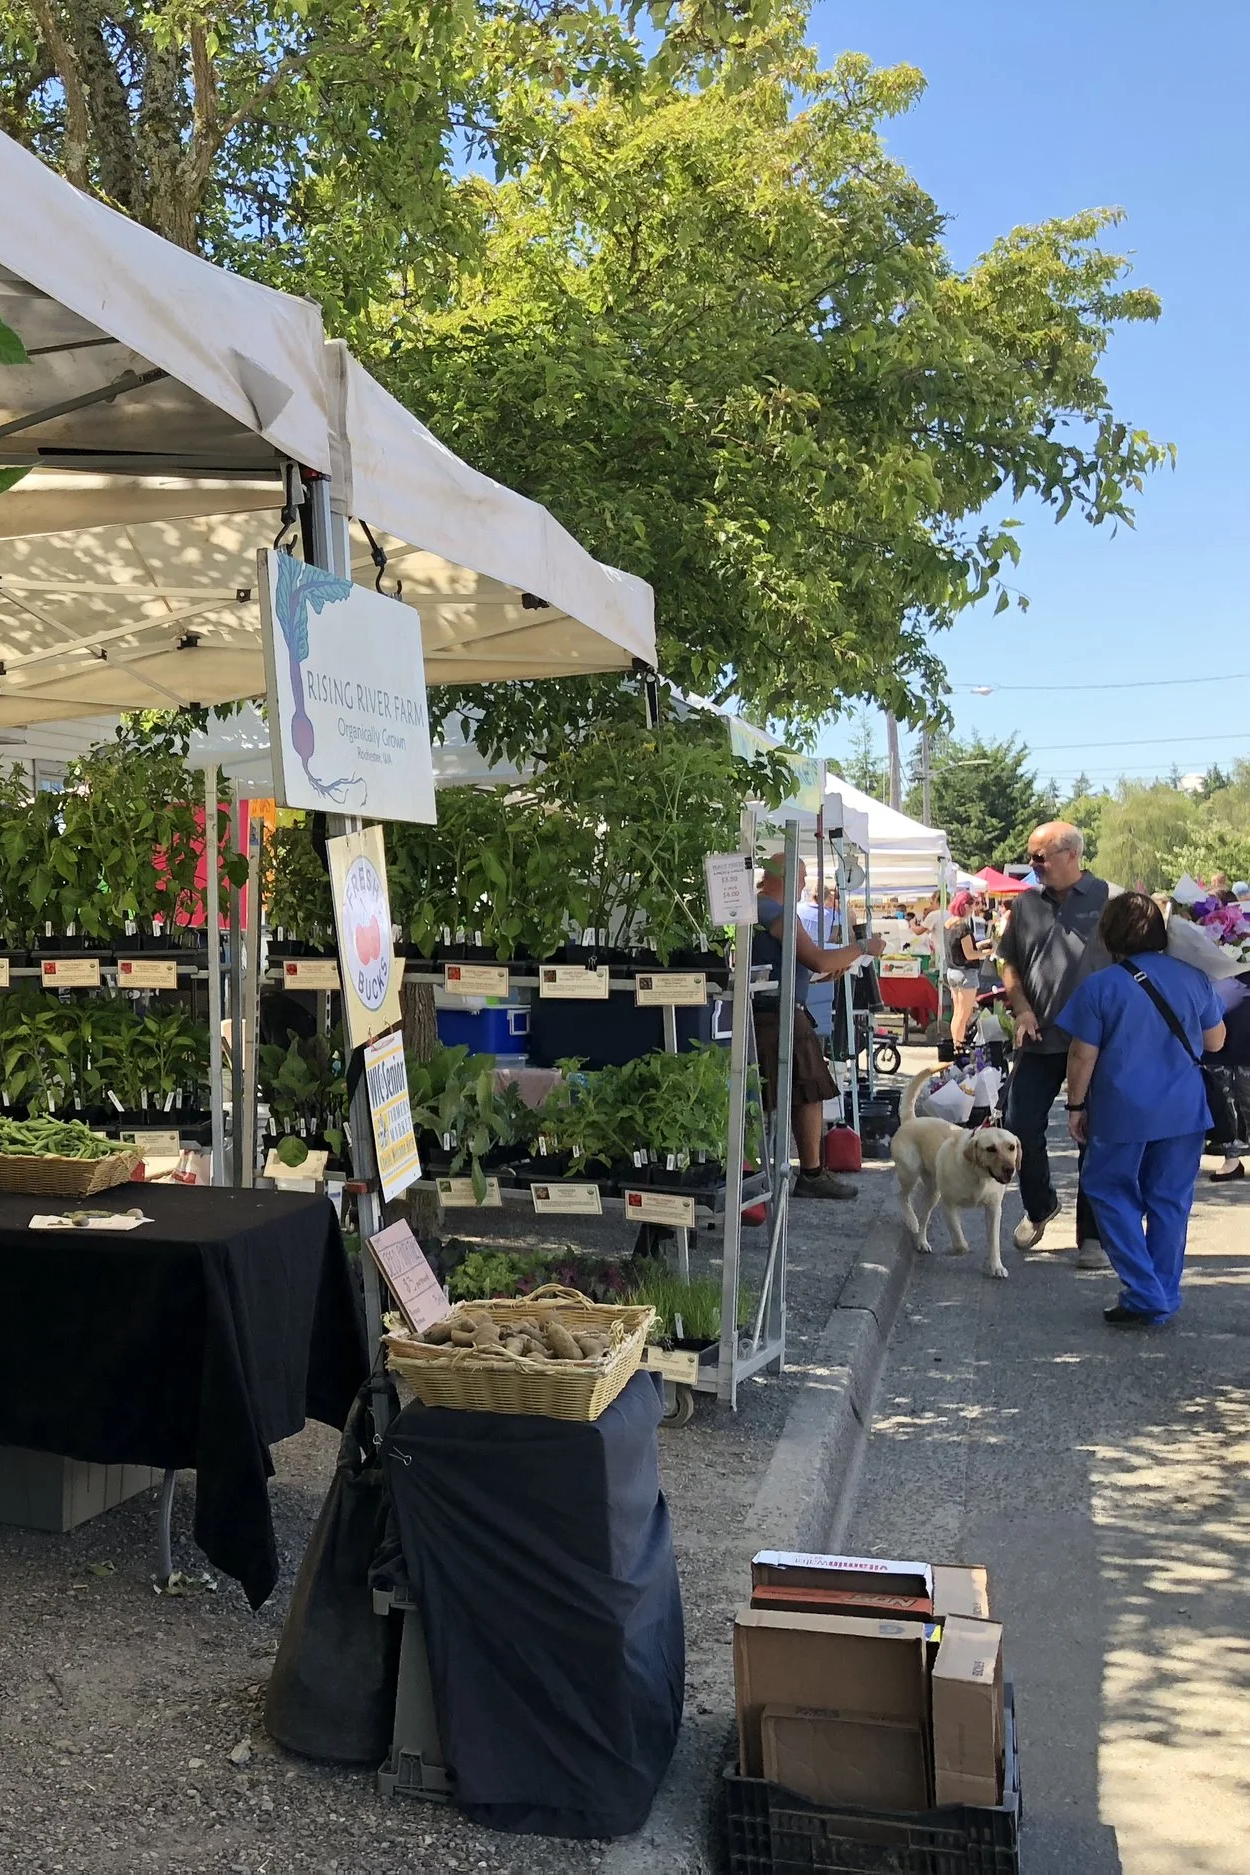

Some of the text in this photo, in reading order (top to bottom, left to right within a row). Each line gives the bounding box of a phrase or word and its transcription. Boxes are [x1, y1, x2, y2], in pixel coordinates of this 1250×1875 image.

[307, 670, 424, 727] RISING RIVER FARM
[338, 717, 406, 750] Organically Grown
[346, 867, 379, 910] FRESH
[358, 957, 387, 1000] BUCKS
[367, 1063, 385, 1109] WIC
[382, 1056, 405, 1100] Senior
[390, 1116, 412, 1141] MARKET
